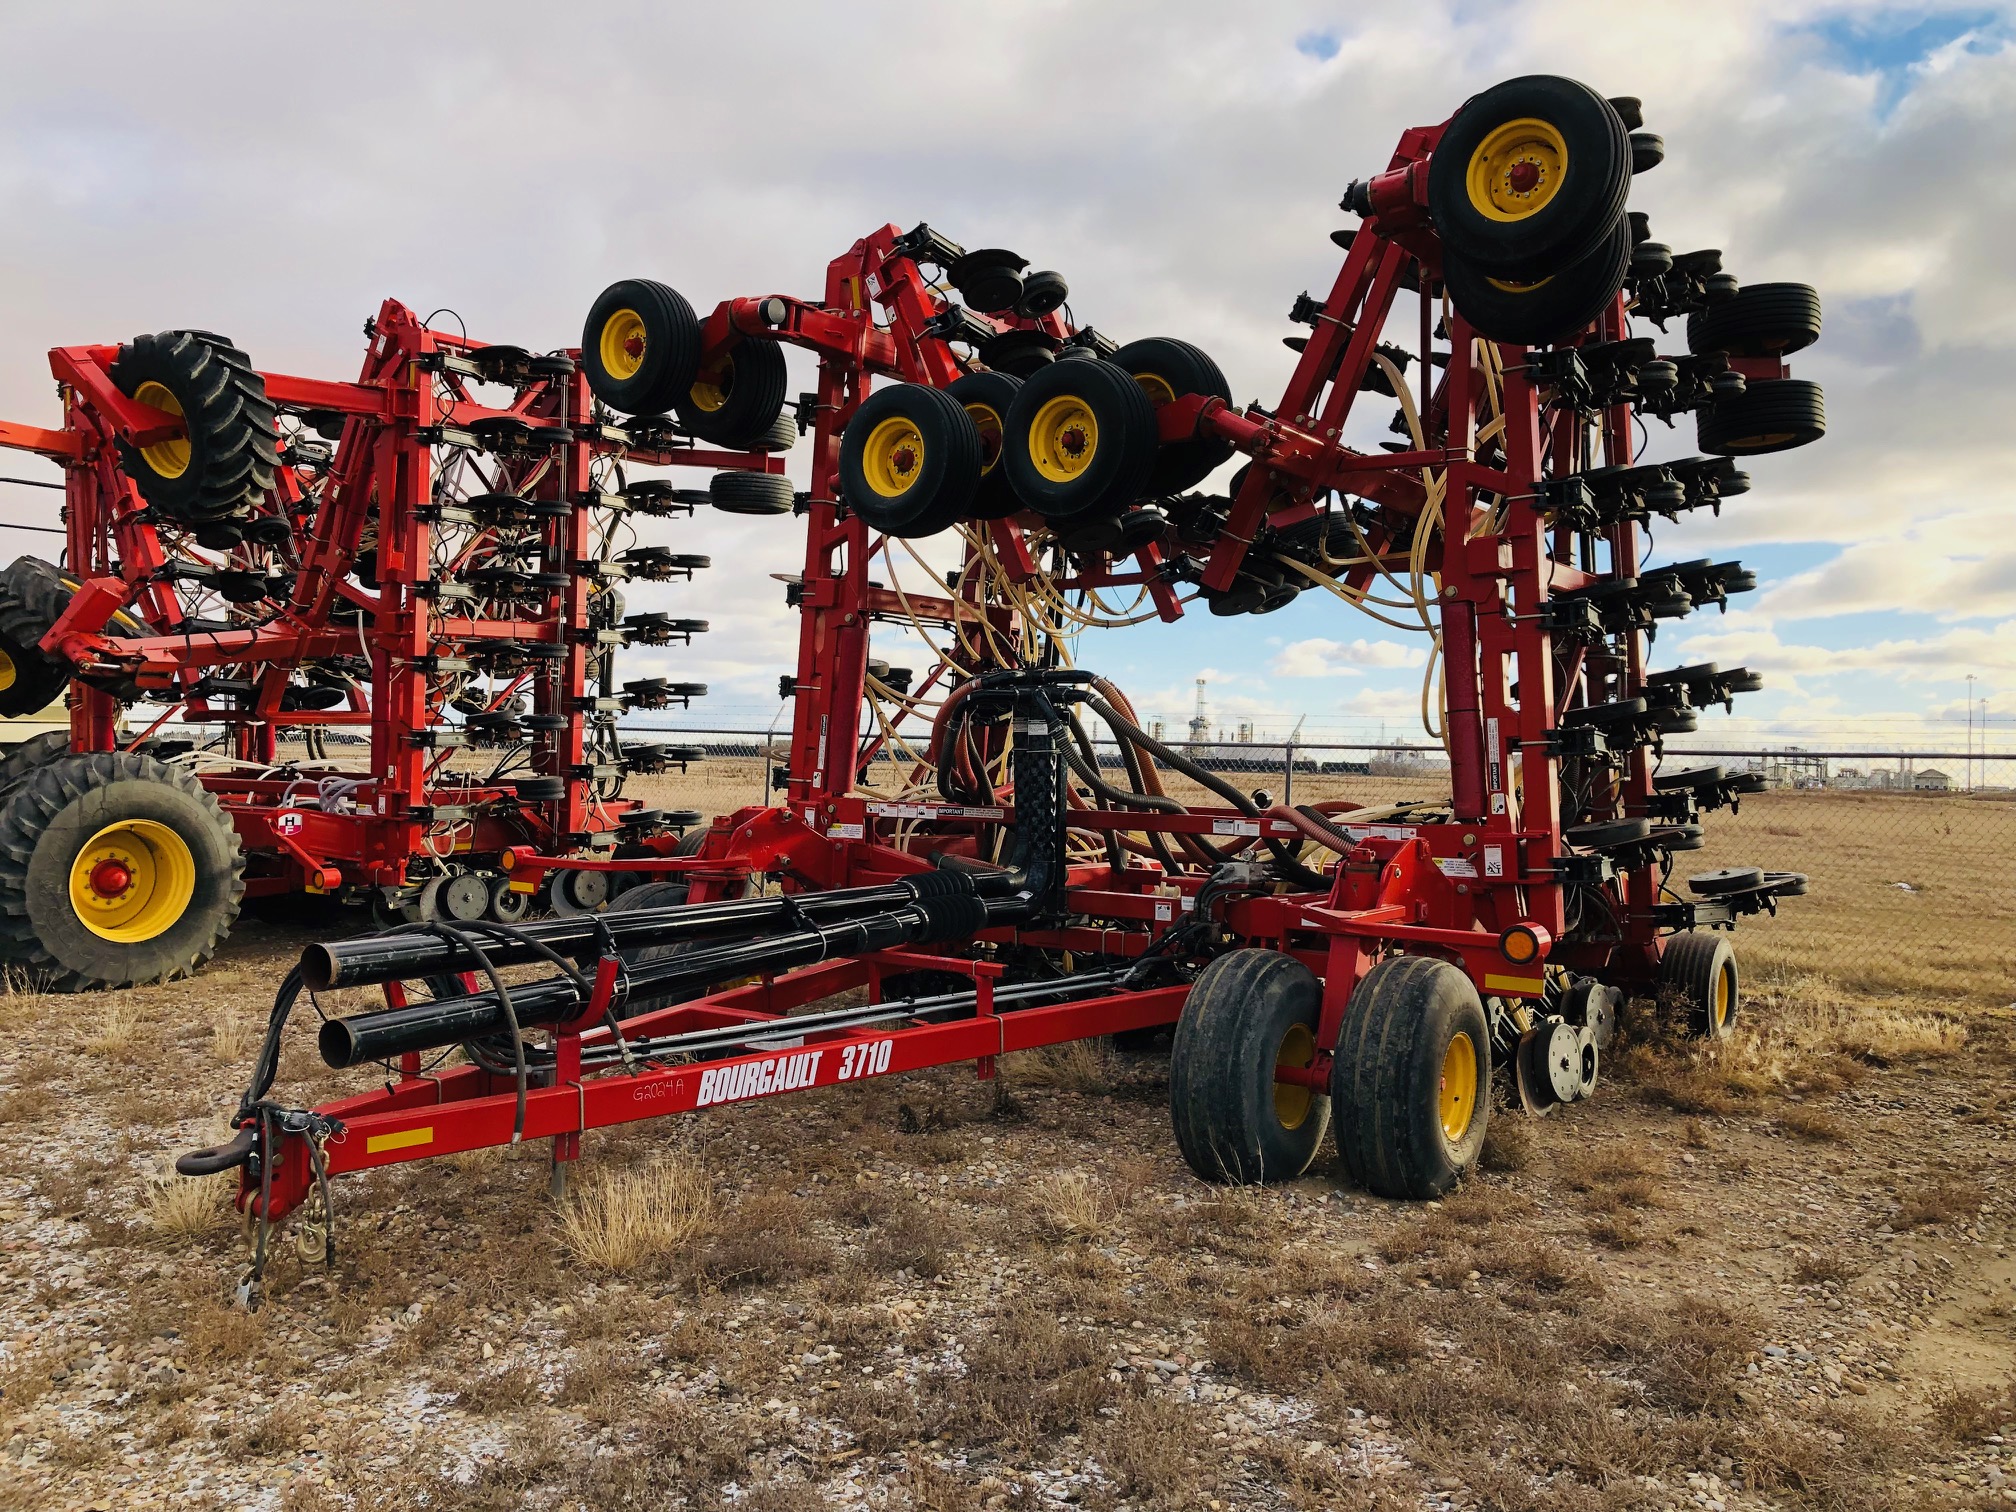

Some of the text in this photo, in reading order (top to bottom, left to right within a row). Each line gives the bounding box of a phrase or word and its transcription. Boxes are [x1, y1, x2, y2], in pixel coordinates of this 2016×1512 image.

[285, 817, 295, 826] H
[696, 1039, 894, 1107] BOURGAULT 3710
[633, 1078, 684, 1101] G2024A
